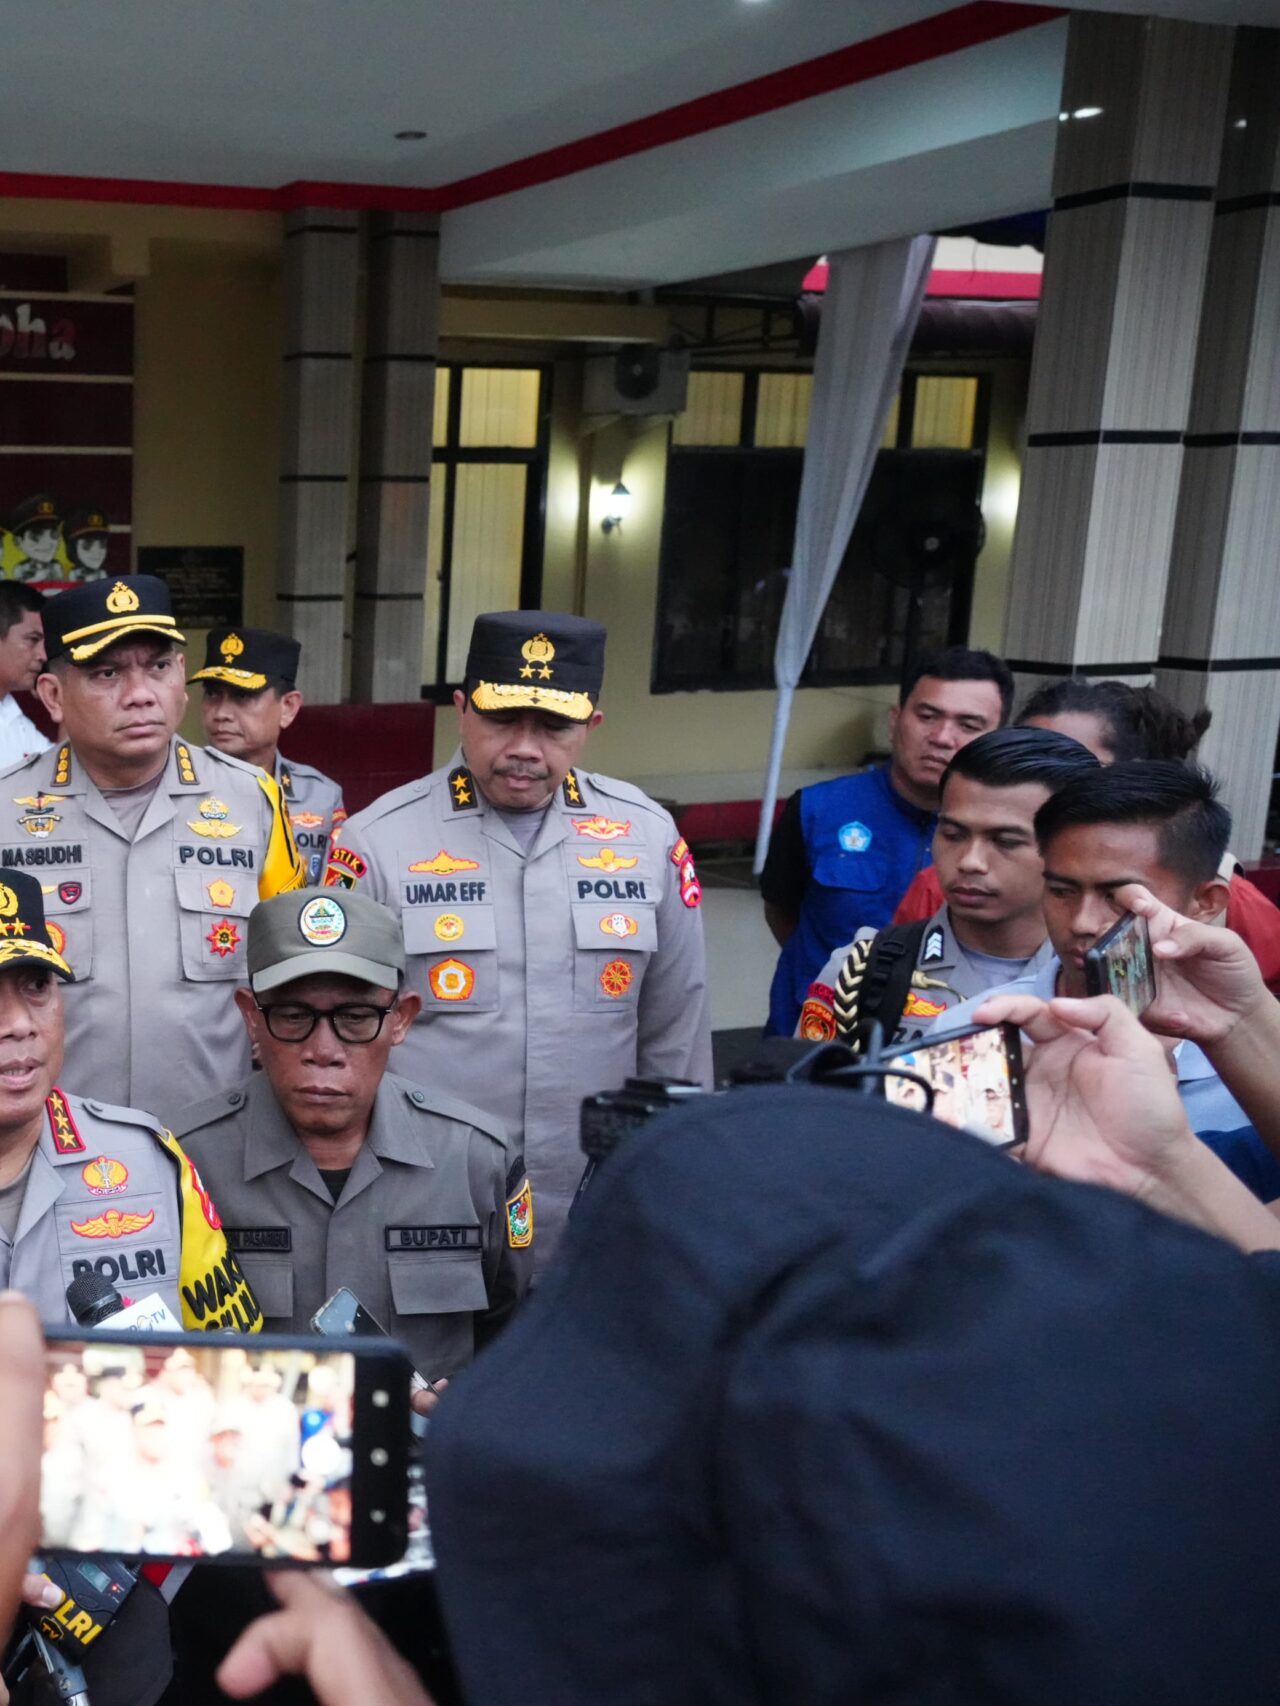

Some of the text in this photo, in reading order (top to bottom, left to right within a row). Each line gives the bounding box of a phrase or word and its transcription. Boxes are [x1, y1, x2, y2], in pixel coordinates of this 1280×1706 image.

[296, 832, 328, 850] OLRI
[2, 844, 83, 867] MASBUDHI
[179, 846, 255, 868] POLRI
[332, 848, 361, 870] STIK
[406, 882, 486, 904] UMAR EFF
[577, 879, 647, 900] POLRI
[400, 1229, 468, 1246] BUPATI
[72, 1248, 167, 1284] POLRI
[53, 1592, 103, 1646] LRI
